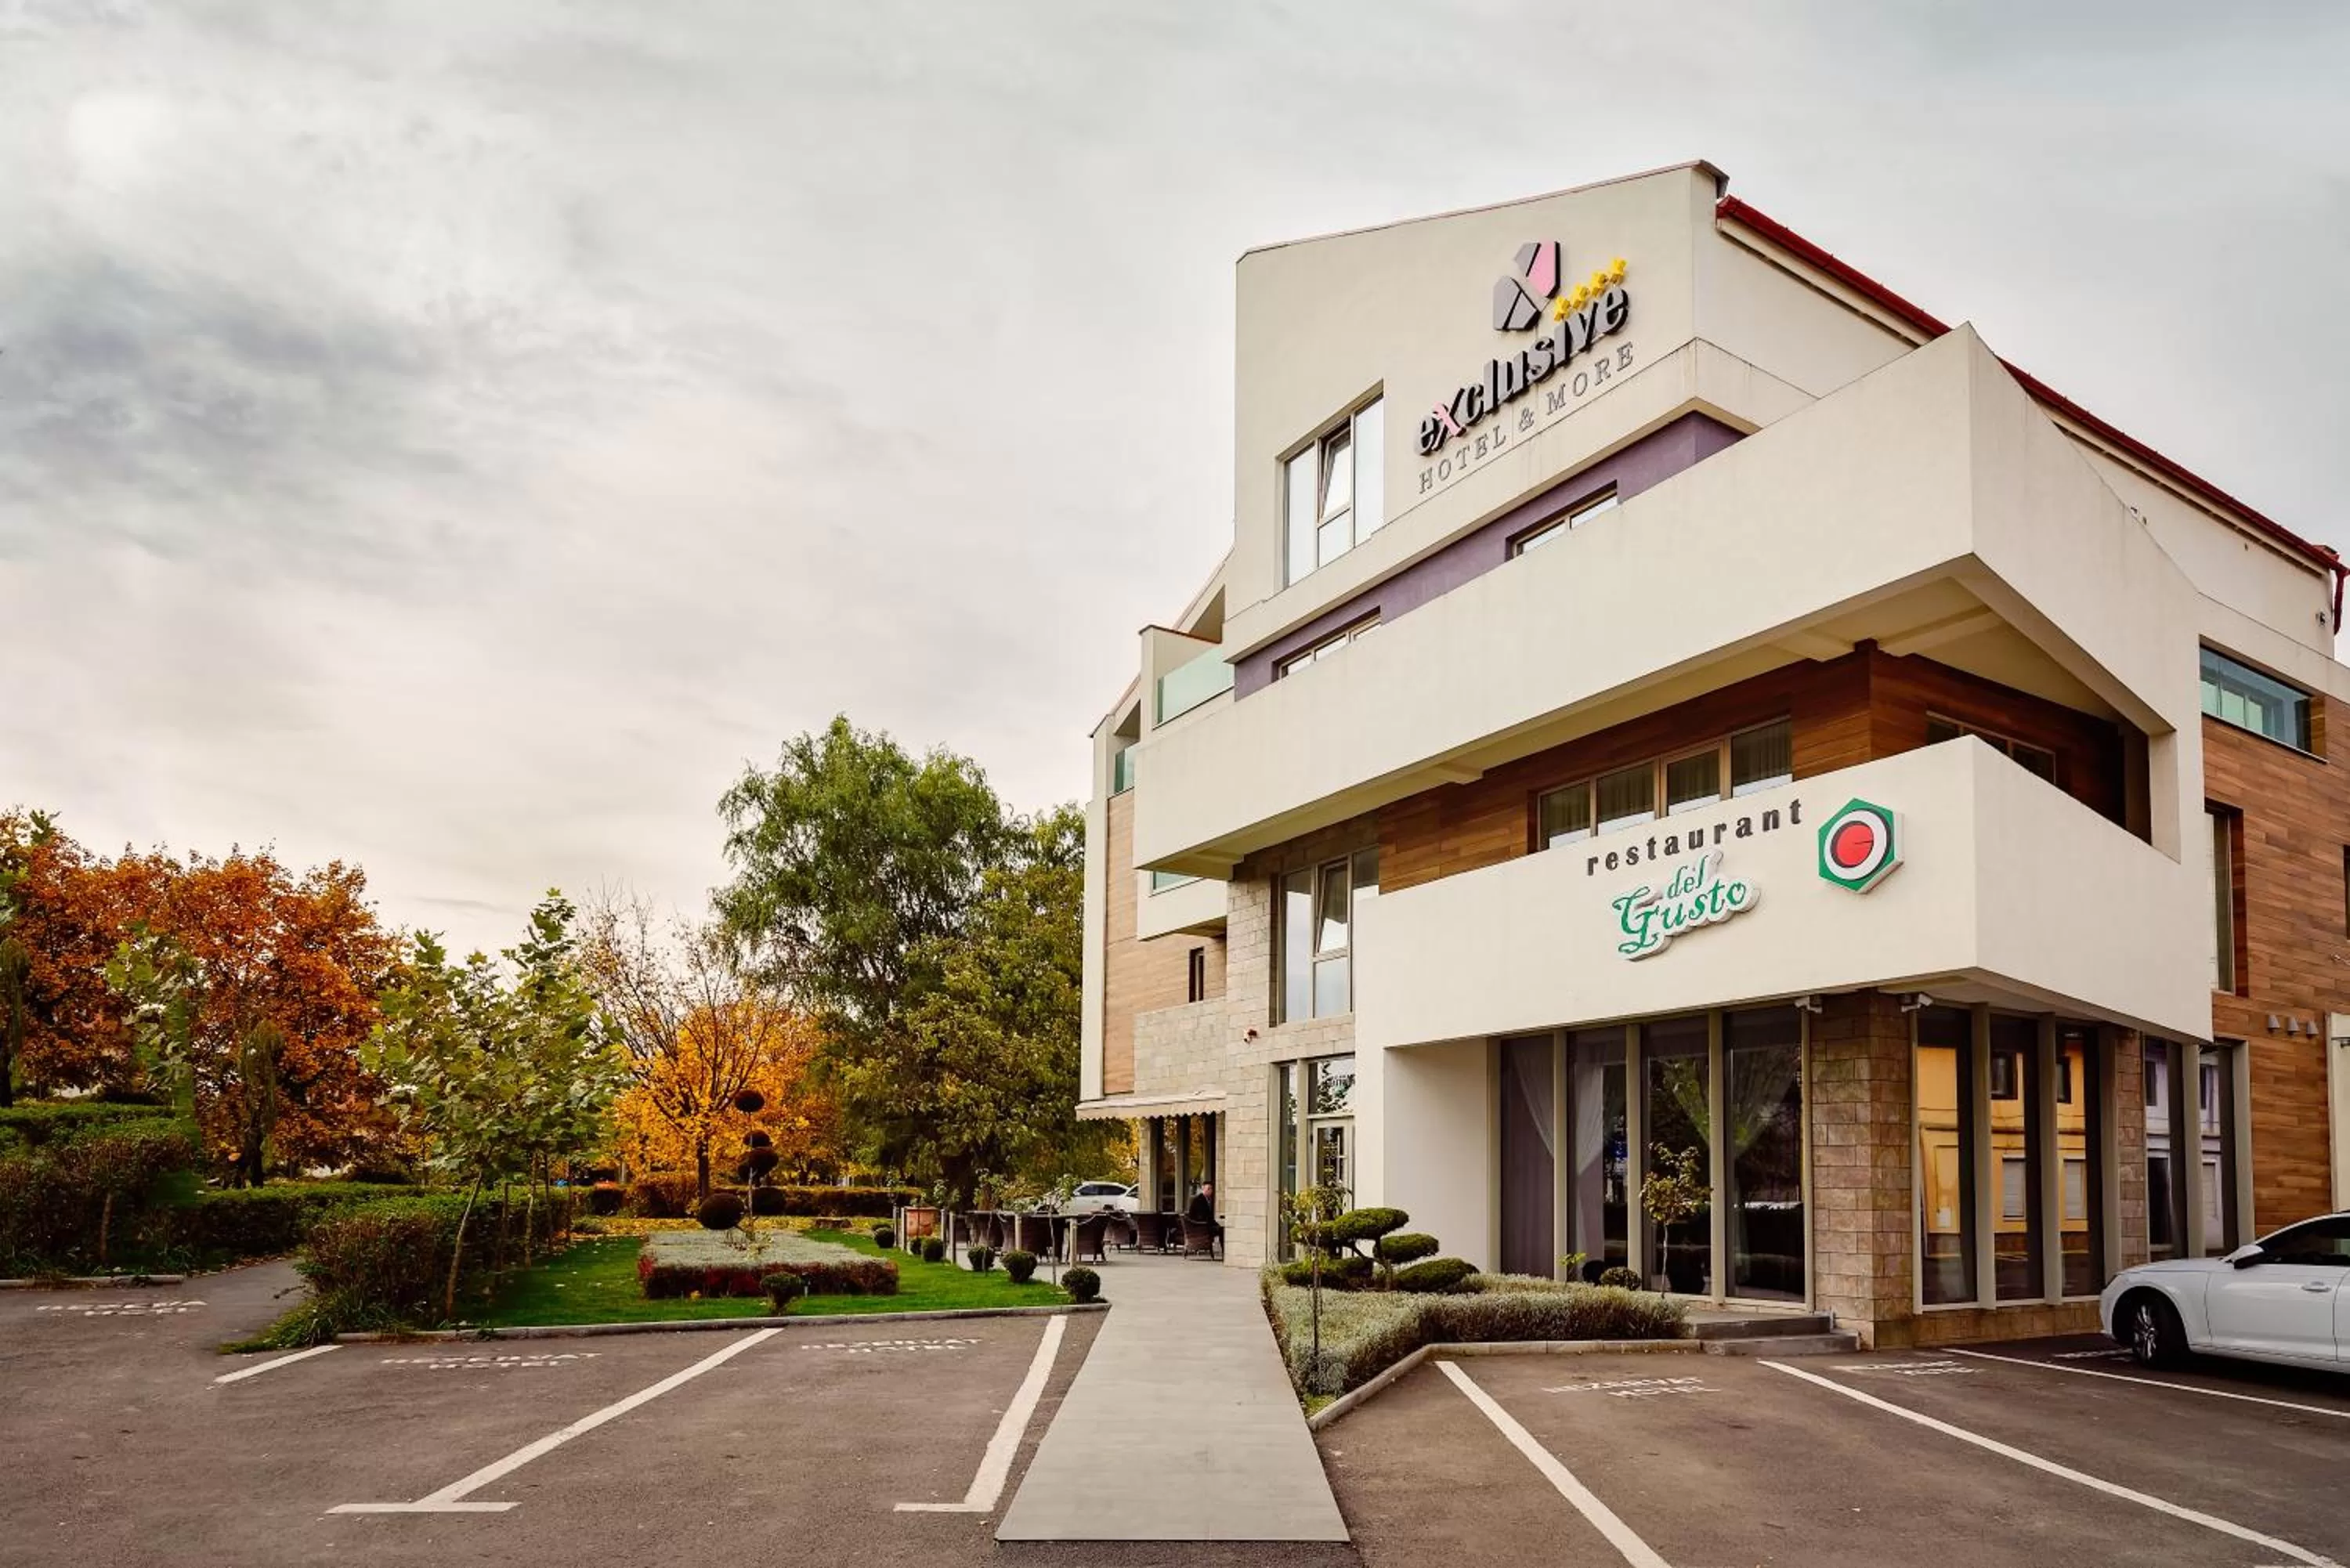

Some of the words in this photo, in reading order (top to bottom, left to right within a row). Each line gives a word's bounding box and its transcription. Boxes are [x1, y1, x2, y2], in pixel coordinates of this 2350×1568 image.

[1415, 287, 1629, 456] exclusive
[1419, 425, 1506, 493] HOTEL
[1519, 407, 1535, 431] &
[1546, 342, 1634, 416] MORE
[1588, 798, 1802, 876] restaurant
[1667, 854, 1710, 901] del
[1612, 880, 1747, 954] Gusto
